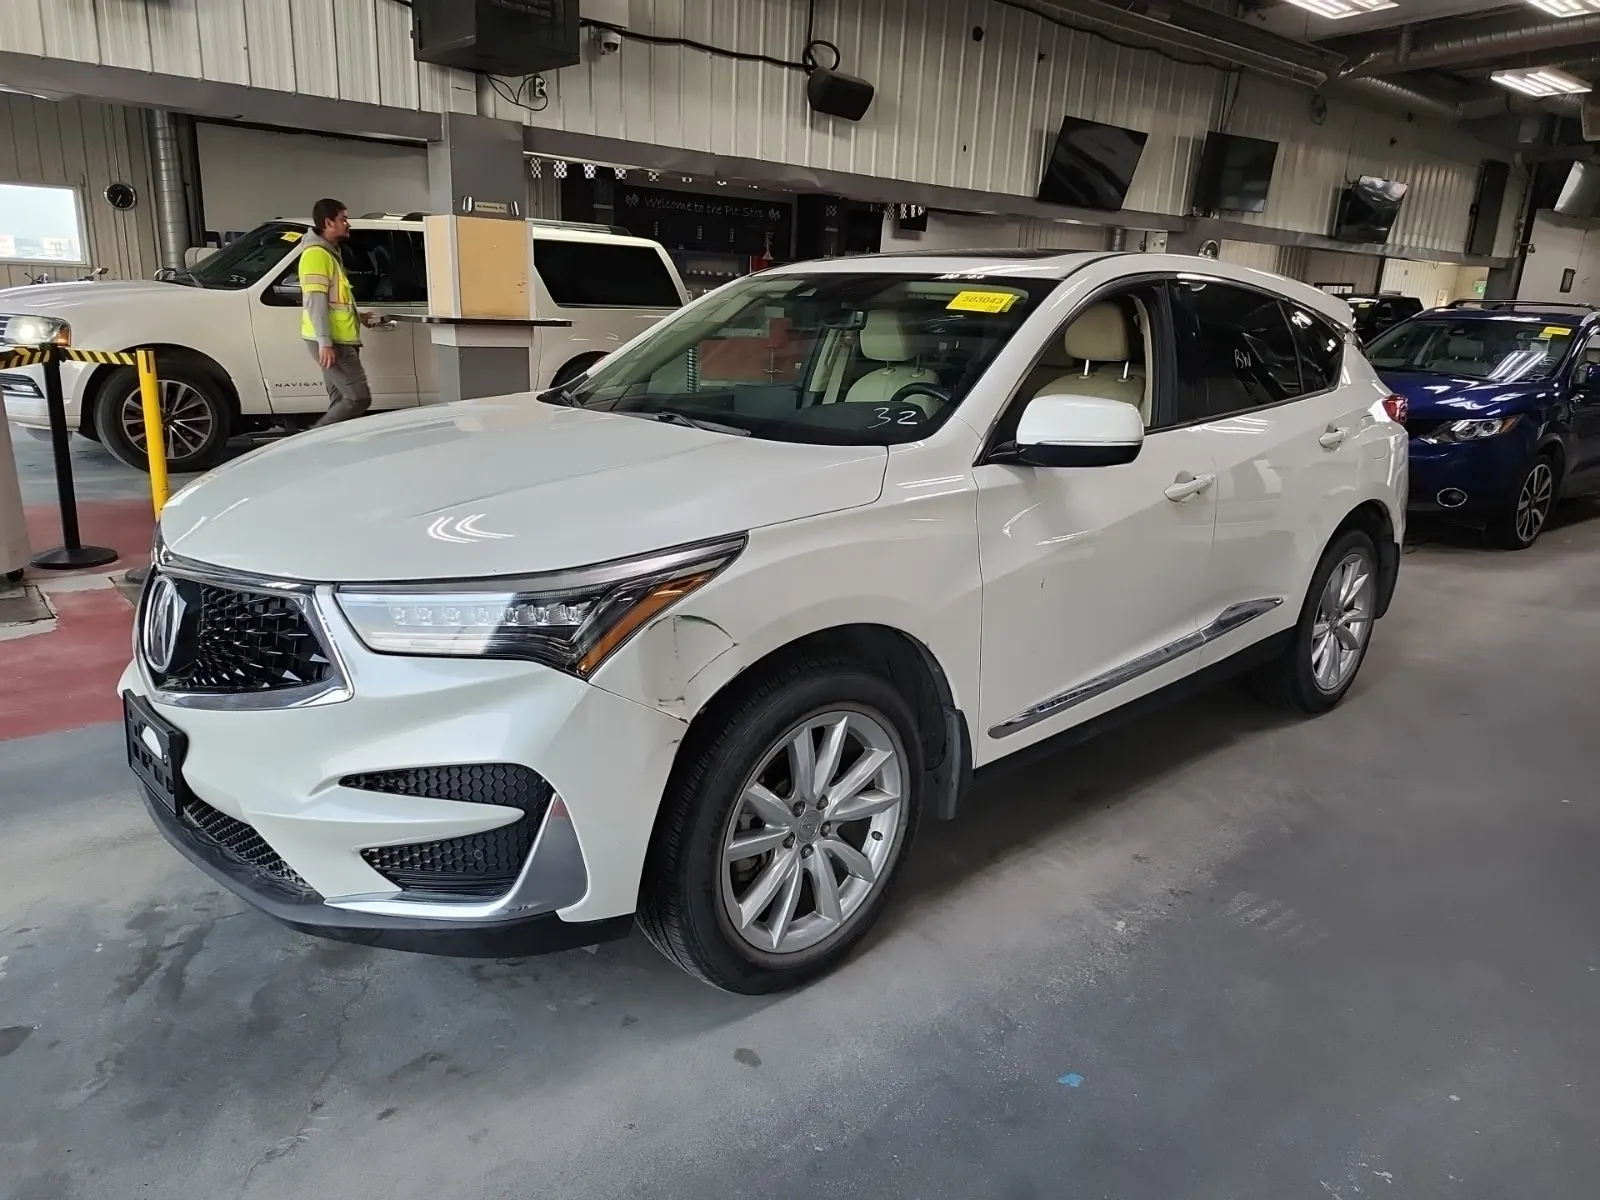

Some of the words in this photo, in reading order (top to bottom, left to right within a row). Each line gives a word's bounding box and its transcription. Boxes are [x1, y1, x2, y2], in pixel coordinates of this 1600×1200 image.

[644, 197, 692, 212] Welcome
[694, 202, 705, 213] to
[707, 203, 722, 215] the
[724, 205, 740, 216] Pit
[742, 207, 765, 219] Stop
[866, 407, 919, 429] 32
